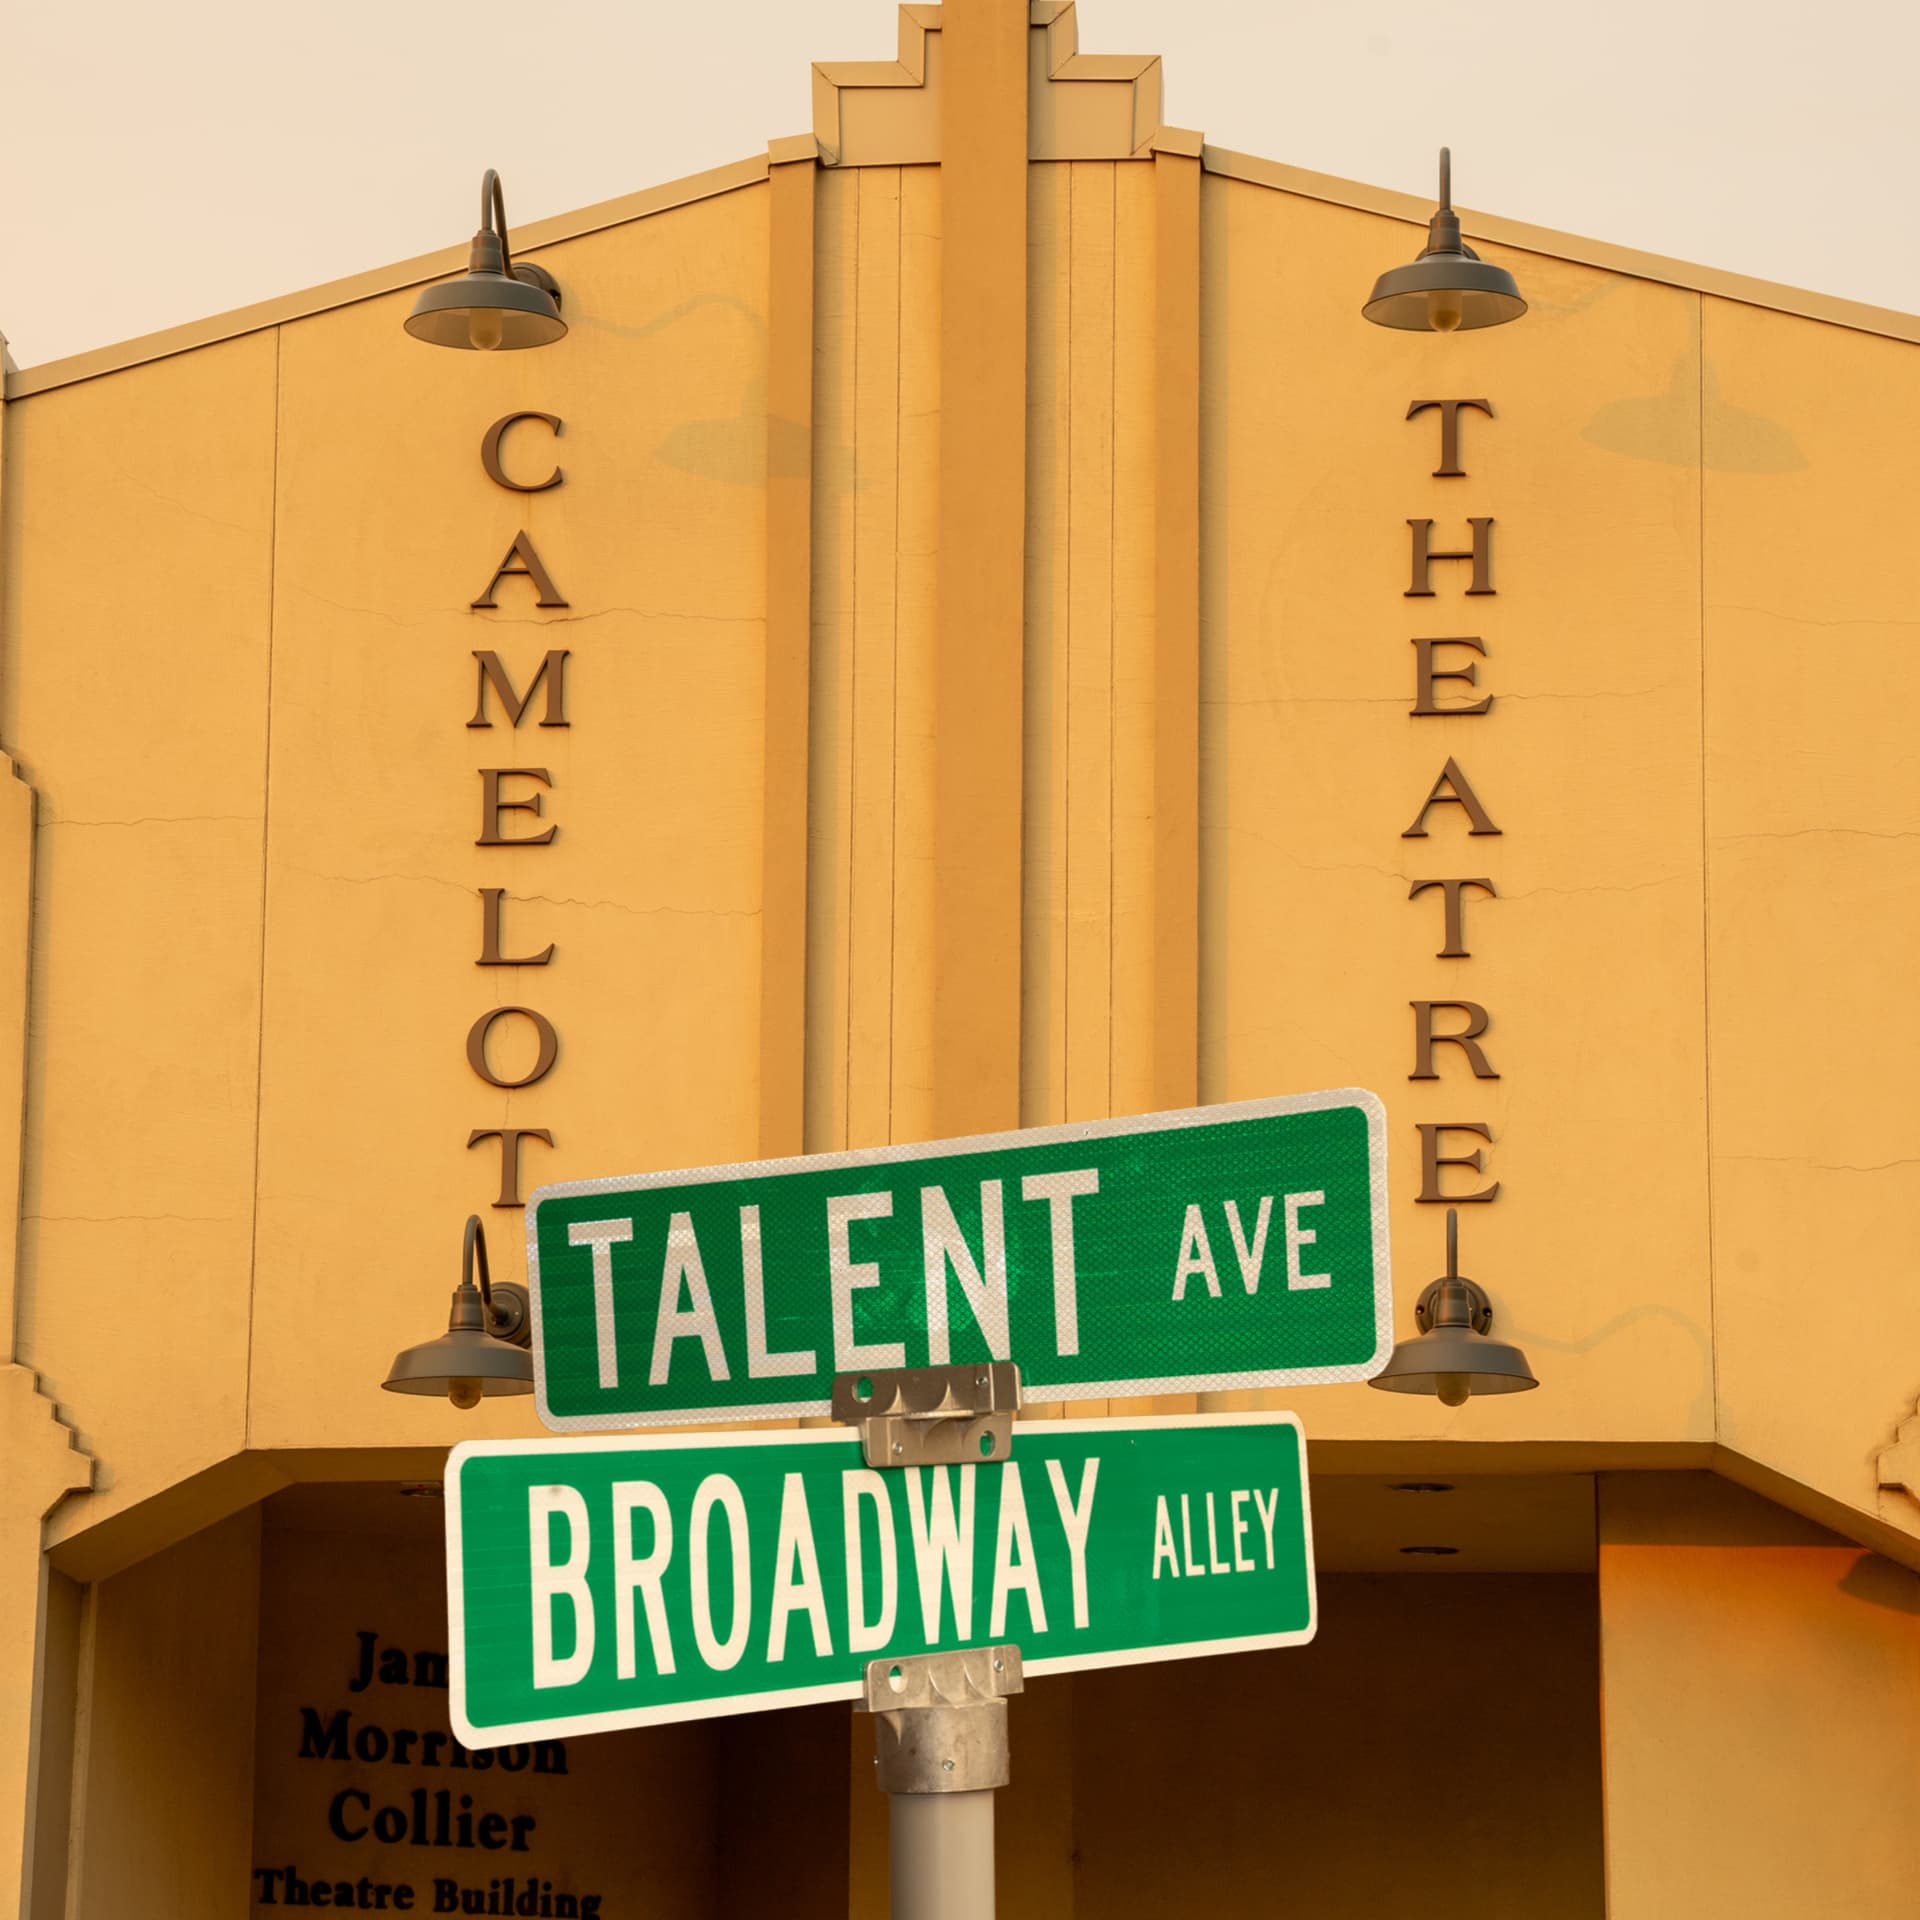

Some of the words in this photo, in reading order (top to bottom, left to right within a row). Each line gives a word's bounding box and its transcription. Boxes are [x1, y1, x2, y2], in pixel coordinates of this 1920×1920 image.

[465, 410, 572, 1208] CAMELOT
[1401, 398, 1504, 1204] THEATRE
[567, 1167, 1100, 1390] TALENT
[1170, 1189, 1332, 1302] AVE
[350, 1631, 449, 1692] Jam
[527, 1456, 1101, 1690] BROADWAY
[1152, 1487, 1279, 1581] ALLEY
[254, 1866, 415, 1910] Theatre
[434, 1878, 602, 1920] Building
[329, 1788, 536, 1851] Collier
